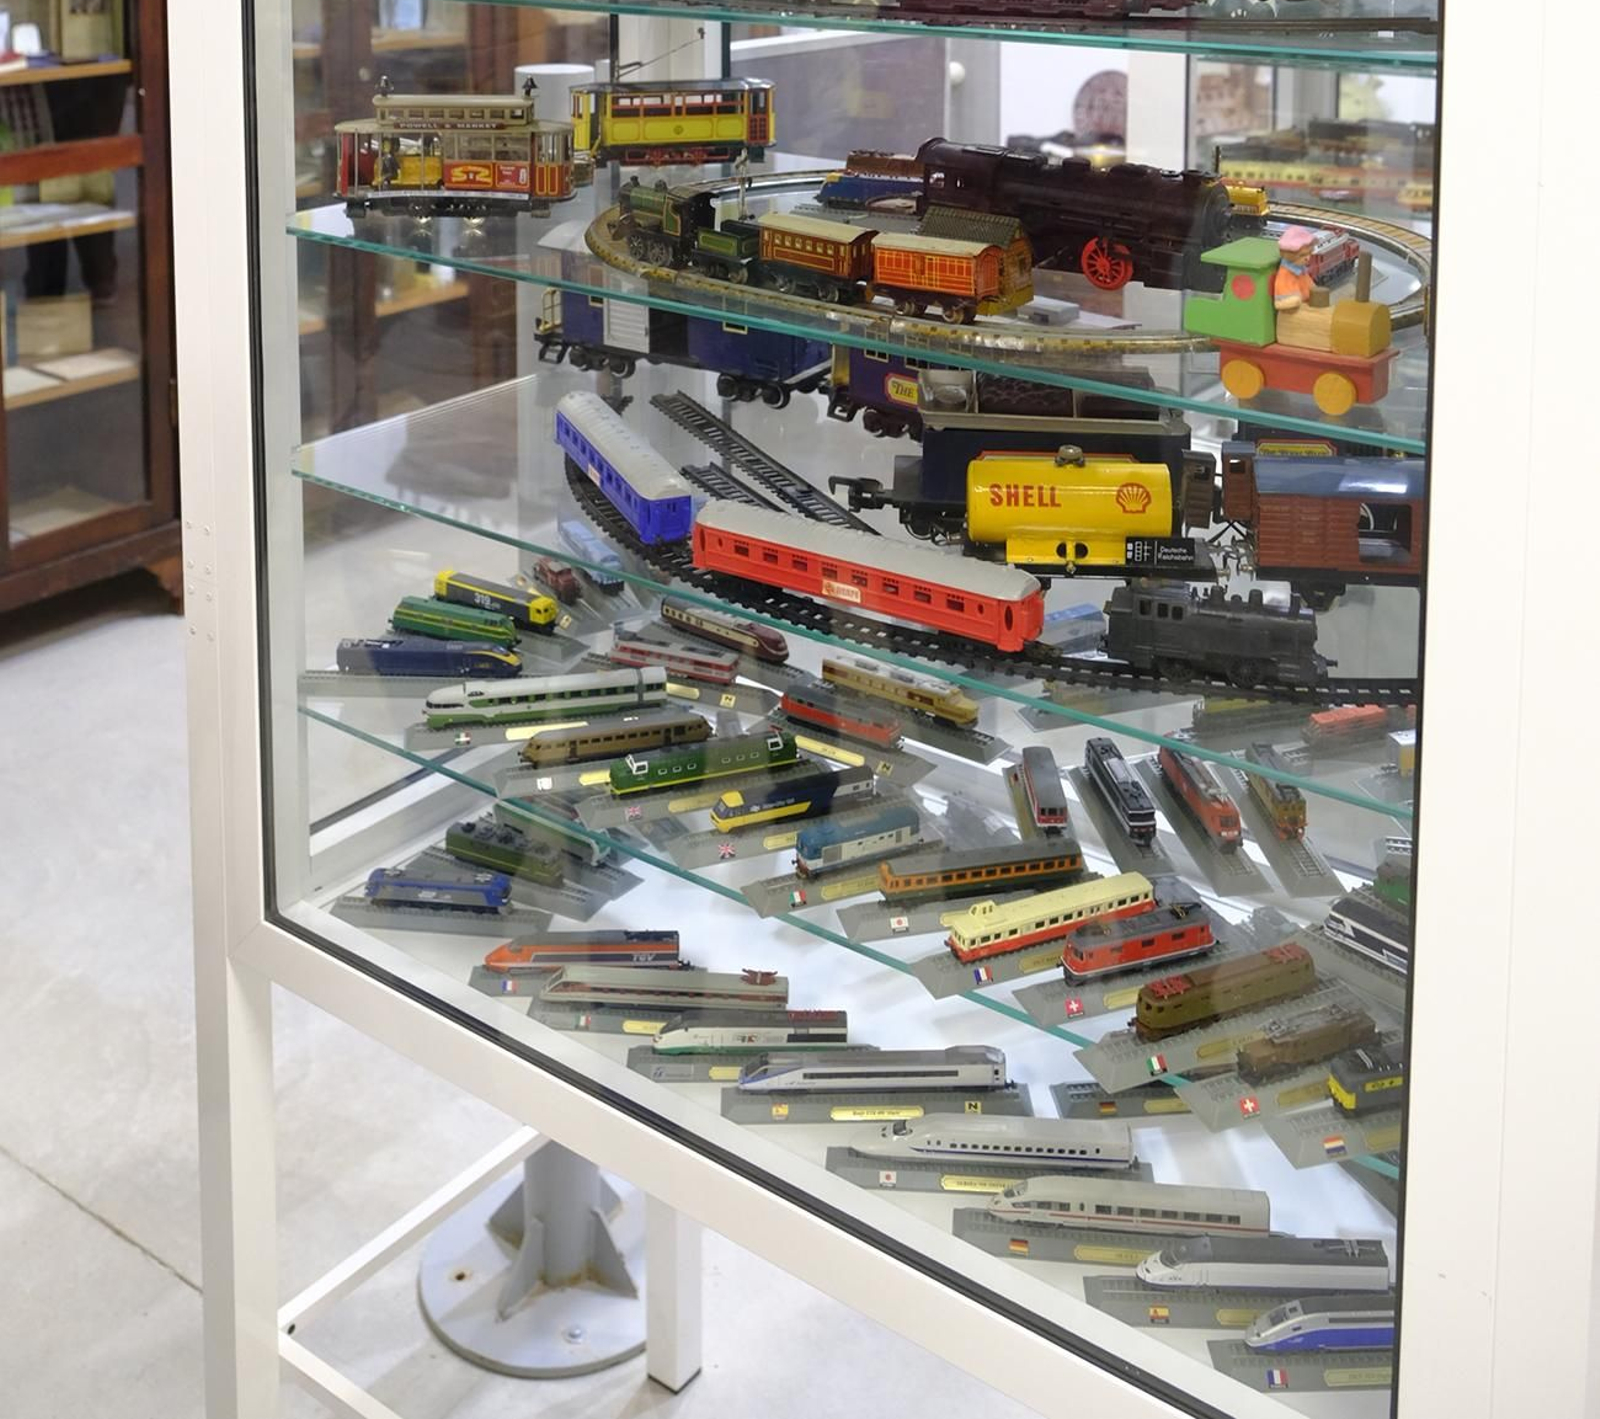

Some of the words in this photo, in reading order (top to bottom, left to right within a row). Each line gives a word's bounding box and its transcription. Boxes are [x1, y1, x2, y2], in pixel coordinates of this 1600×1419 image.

[891, 380, 915, 398] THE
[989, 483, 1061, 508] SHELL
[631, 954, 656, 962] TGV
[968, 1102, 978, 1111] N
